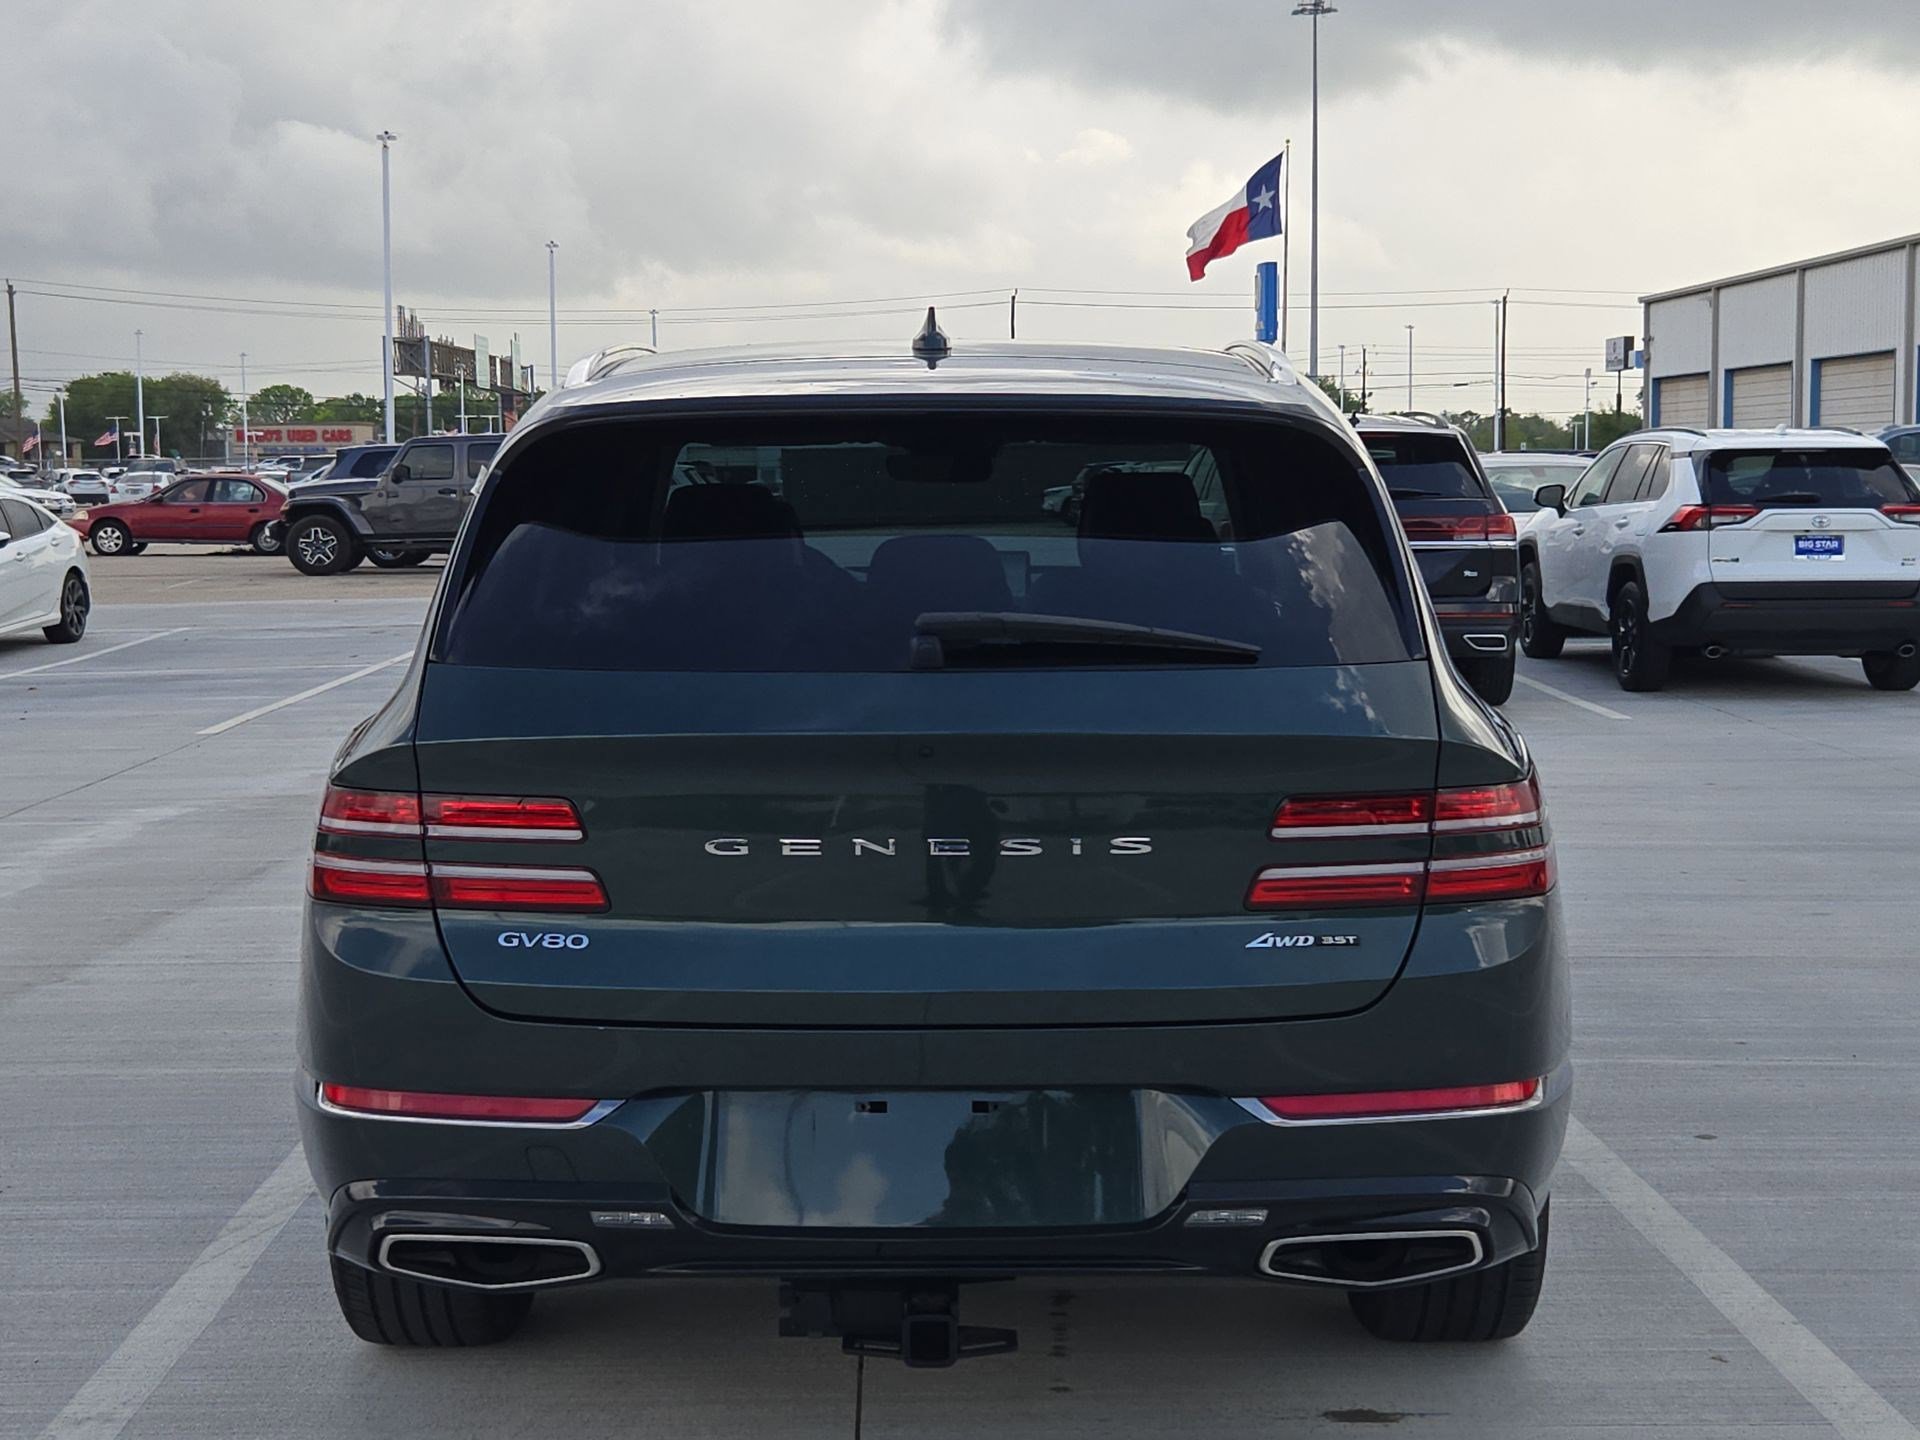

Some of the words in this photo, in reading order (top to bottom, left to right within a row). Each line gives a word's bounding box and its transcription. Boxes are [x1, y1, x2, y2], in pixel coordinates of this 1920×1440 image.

[286, 429, 318, 442] USED
[322, 429, 352, 442] CARS
[1798, 540, 1814, 549] BIG
[1815, 540, 1839, 549] STAR
[704, 837, 1153, 856] GENESIS
[497, 931, 590, 950] GV80
